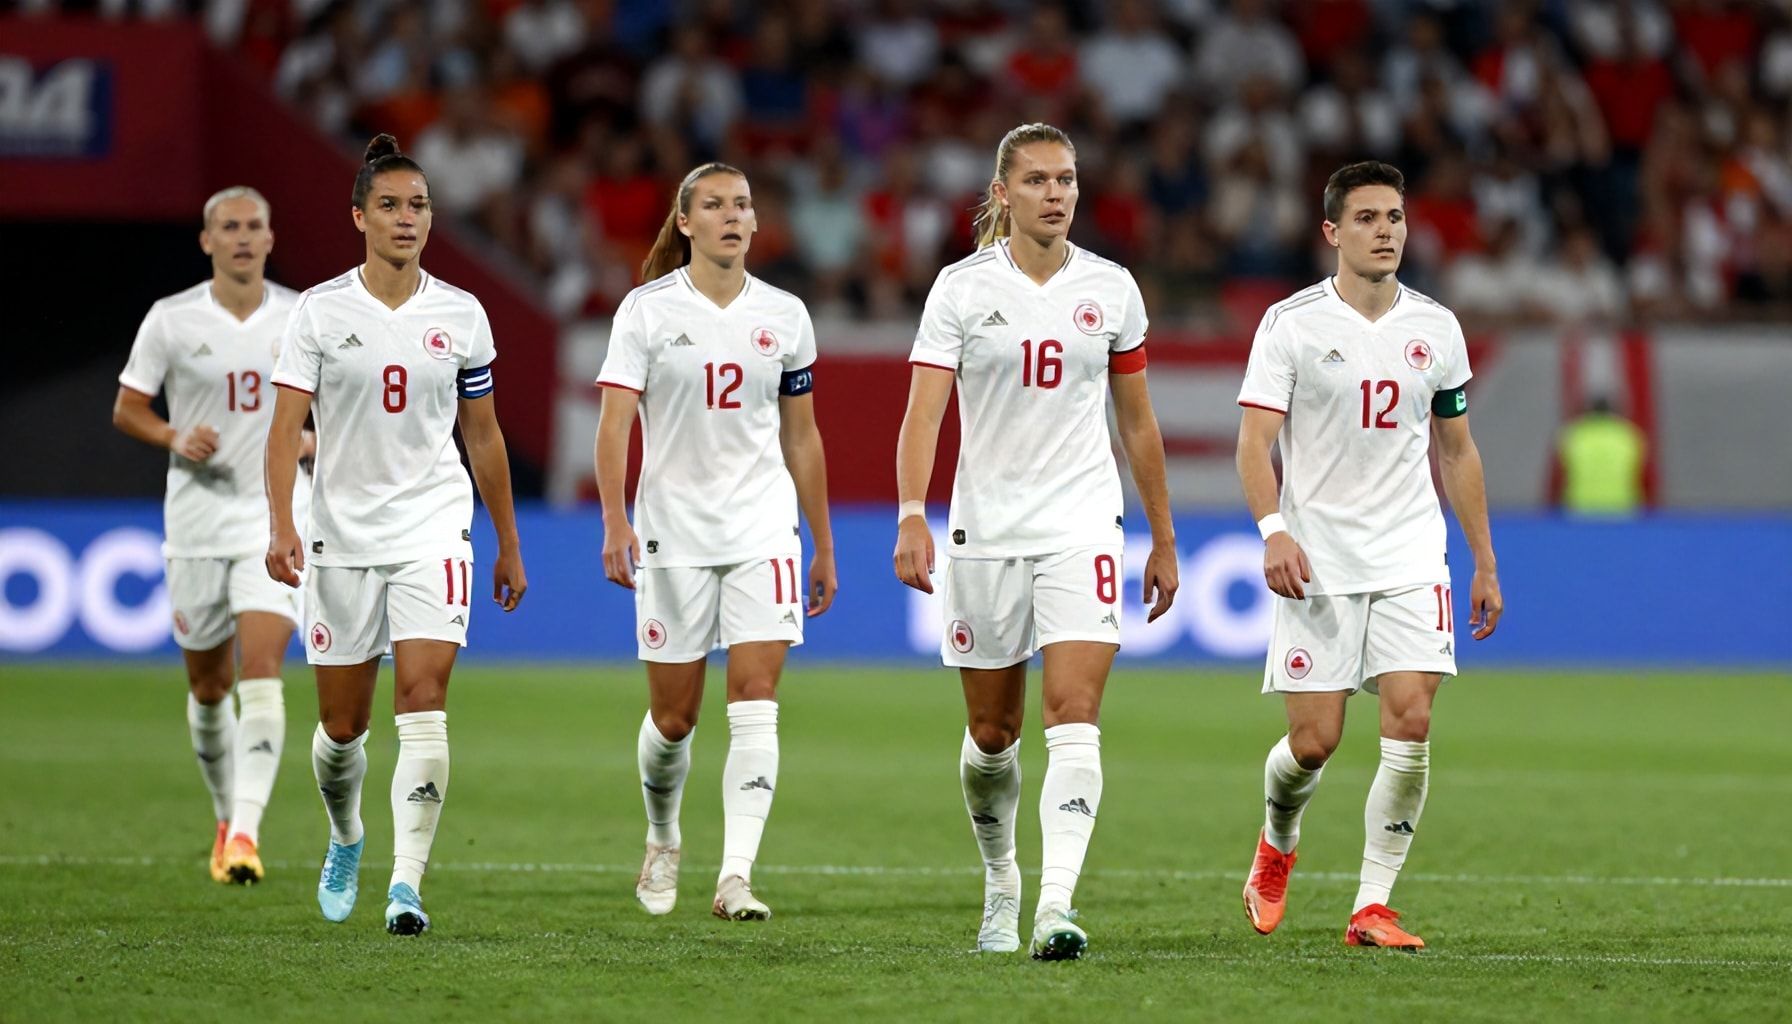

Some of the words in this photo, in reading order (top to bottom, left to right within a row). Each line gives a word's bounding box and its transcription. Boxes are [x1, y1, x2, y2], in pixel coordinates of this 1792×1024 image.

[704, 362, 744, 409] 12
[1021, 339, 1063, 389] 16
[227, 370, 261, 412] 13
[383, 365, 408, 413] 8
[1360, 379, 1400, 429] 12
[444, 558, 468, 606] 11
[770, 558, 798, 604] 11
[1094, 554, 1117, 605] 8
